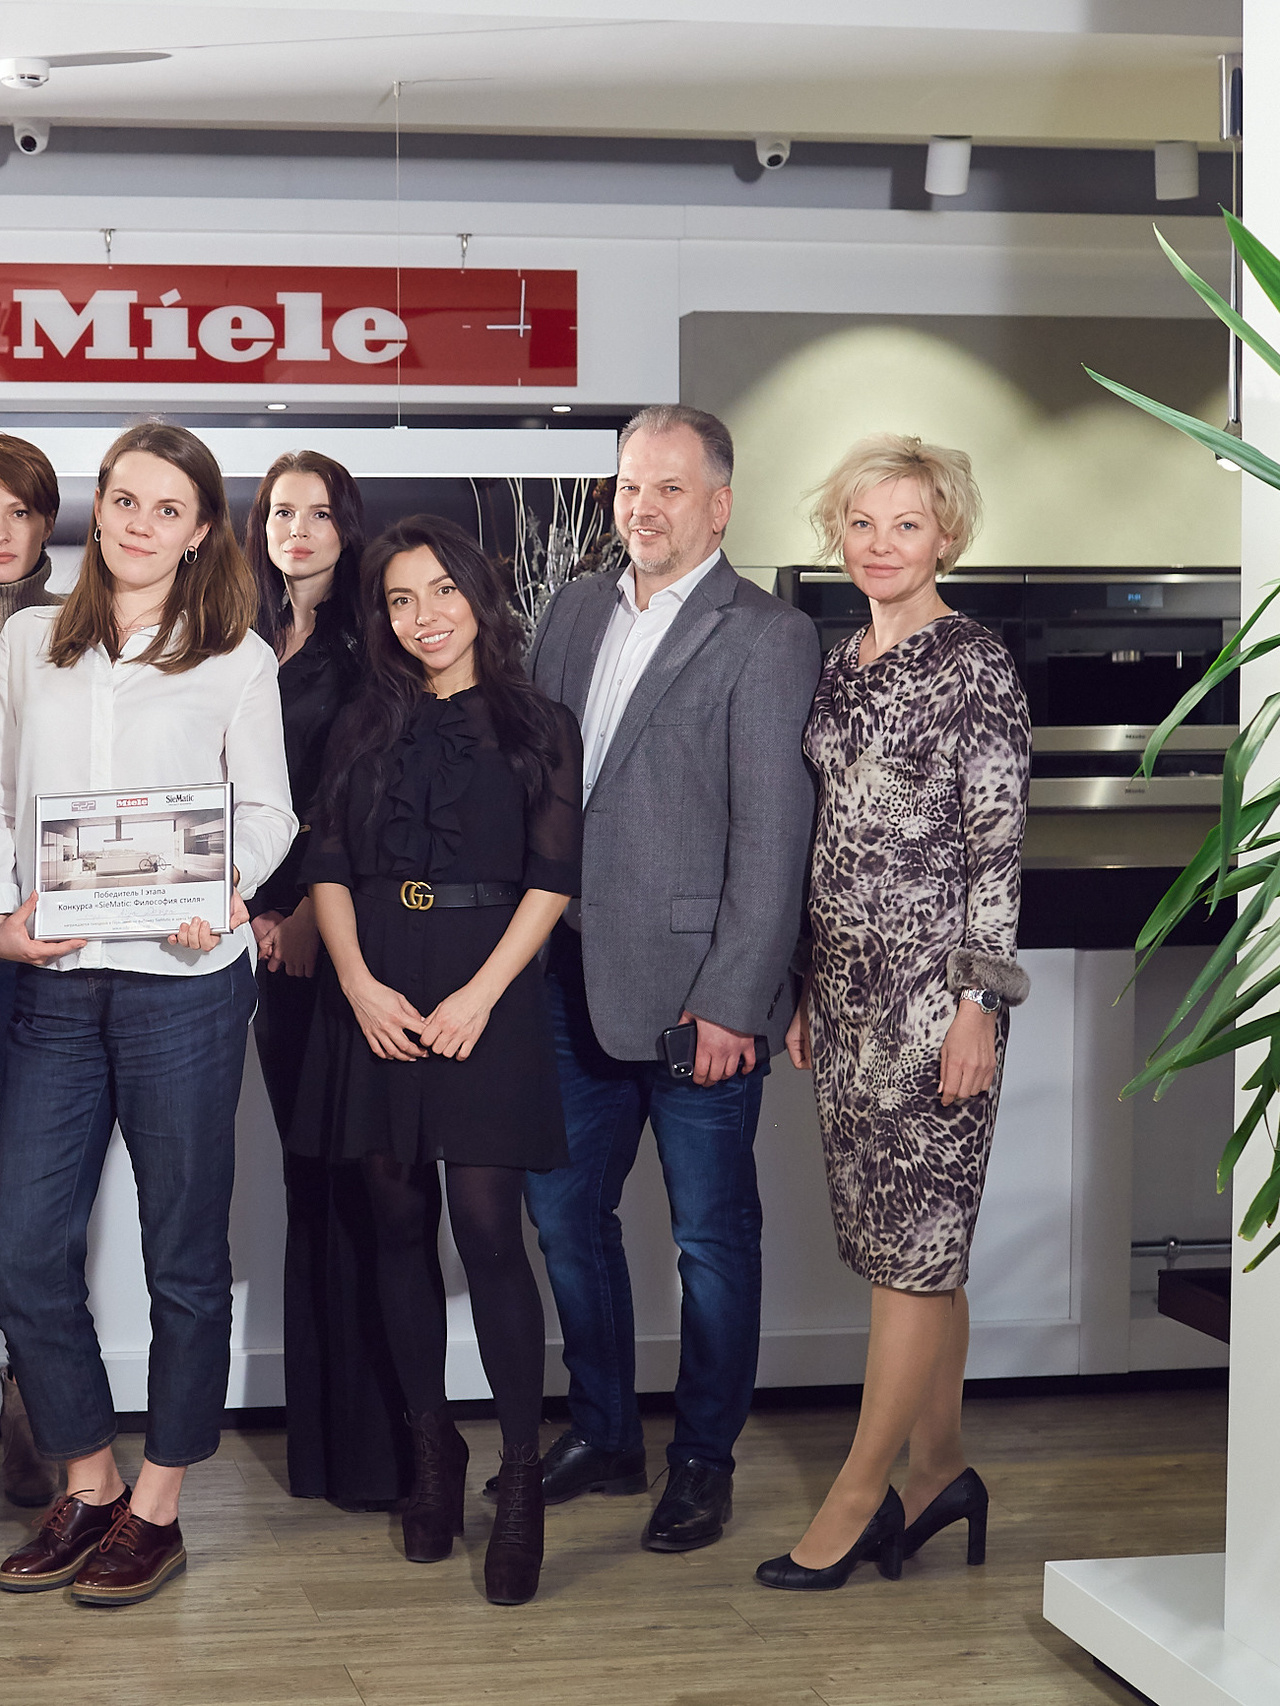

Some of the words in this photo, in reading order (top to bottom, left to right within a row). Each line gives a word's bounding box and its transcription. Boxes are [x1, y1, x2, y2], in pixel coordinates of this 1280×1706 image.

[12, 288, 408, 364] Miele
[116, 798, 148, 808] Miele
[165, 793, 195, 804] SieMatic
[94, 890, 139, 899] Победитель
[145, 888, 166, 896] этапа
[58, 902, 93, 912] Конкурса
[133, 898, 178, 906] Философия
[179, 896, 205, 904] стиля»
